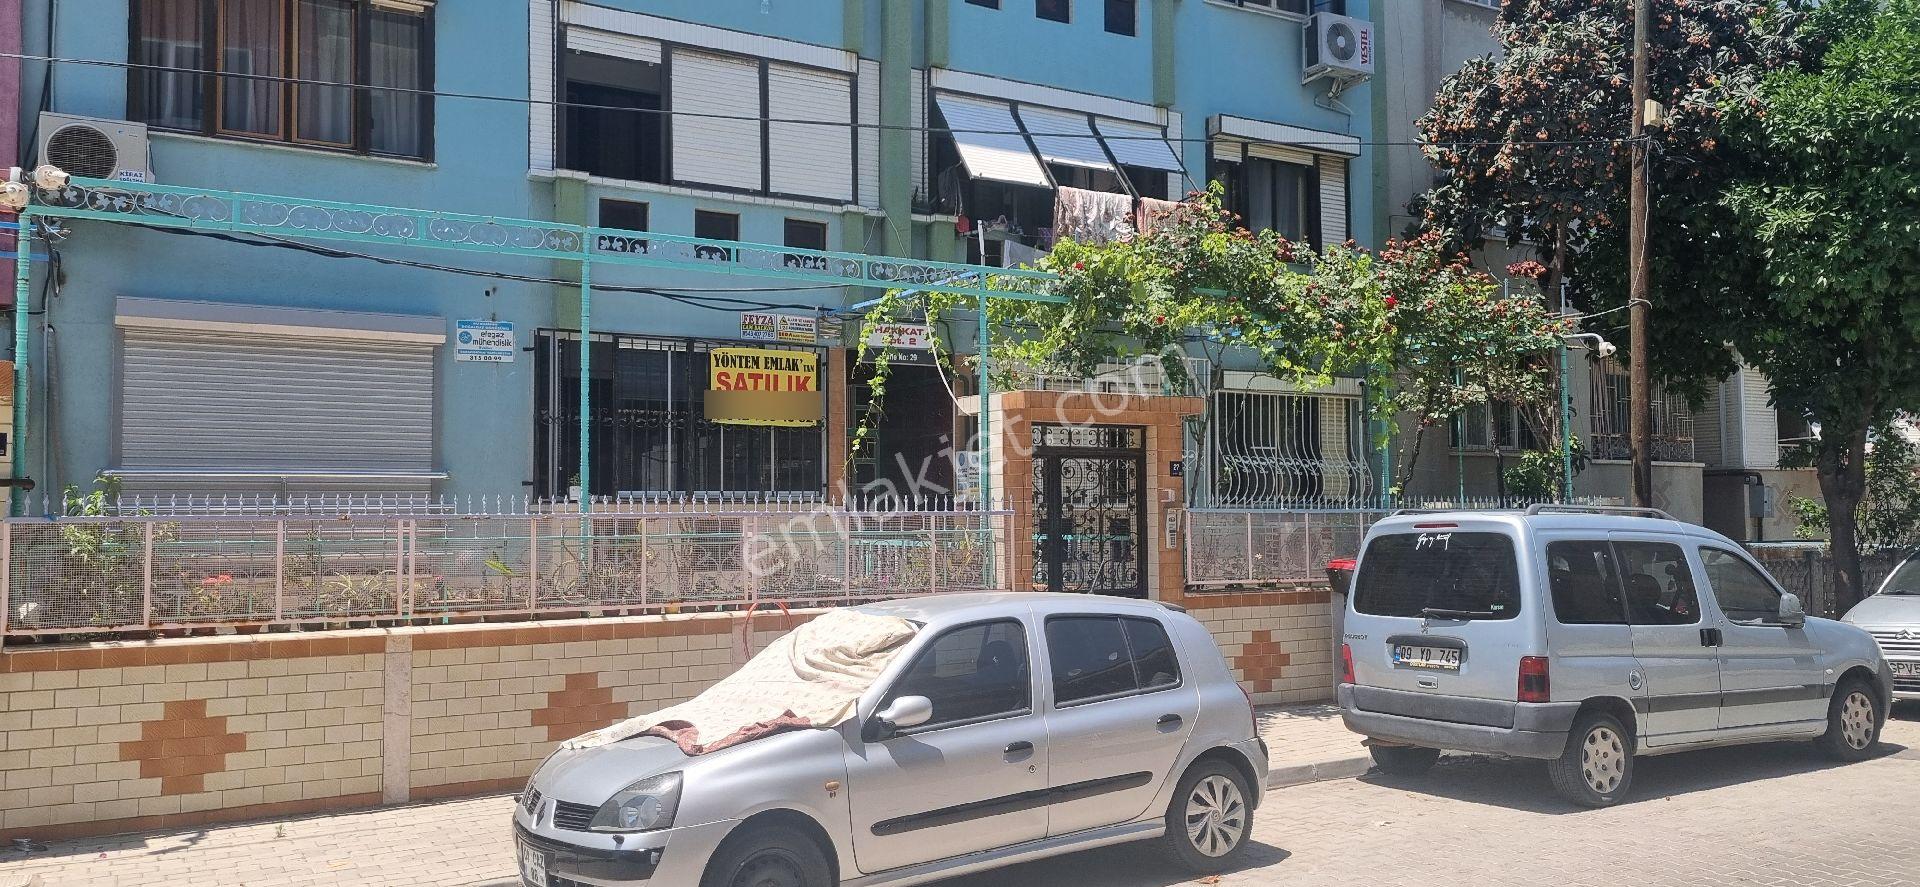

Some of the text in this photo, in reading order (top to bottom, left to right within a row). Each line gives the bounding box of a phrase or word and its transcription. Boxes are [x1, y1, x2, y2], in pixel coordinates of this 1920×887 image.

[742, 314, 774, 325] FEYZA
[909, 338, 917, 346] 2
[713, 352, 760, 370] YÖNTEM
[1400, 646, 1412, 660] 09
[1440, 650, 1457, 664] 745
